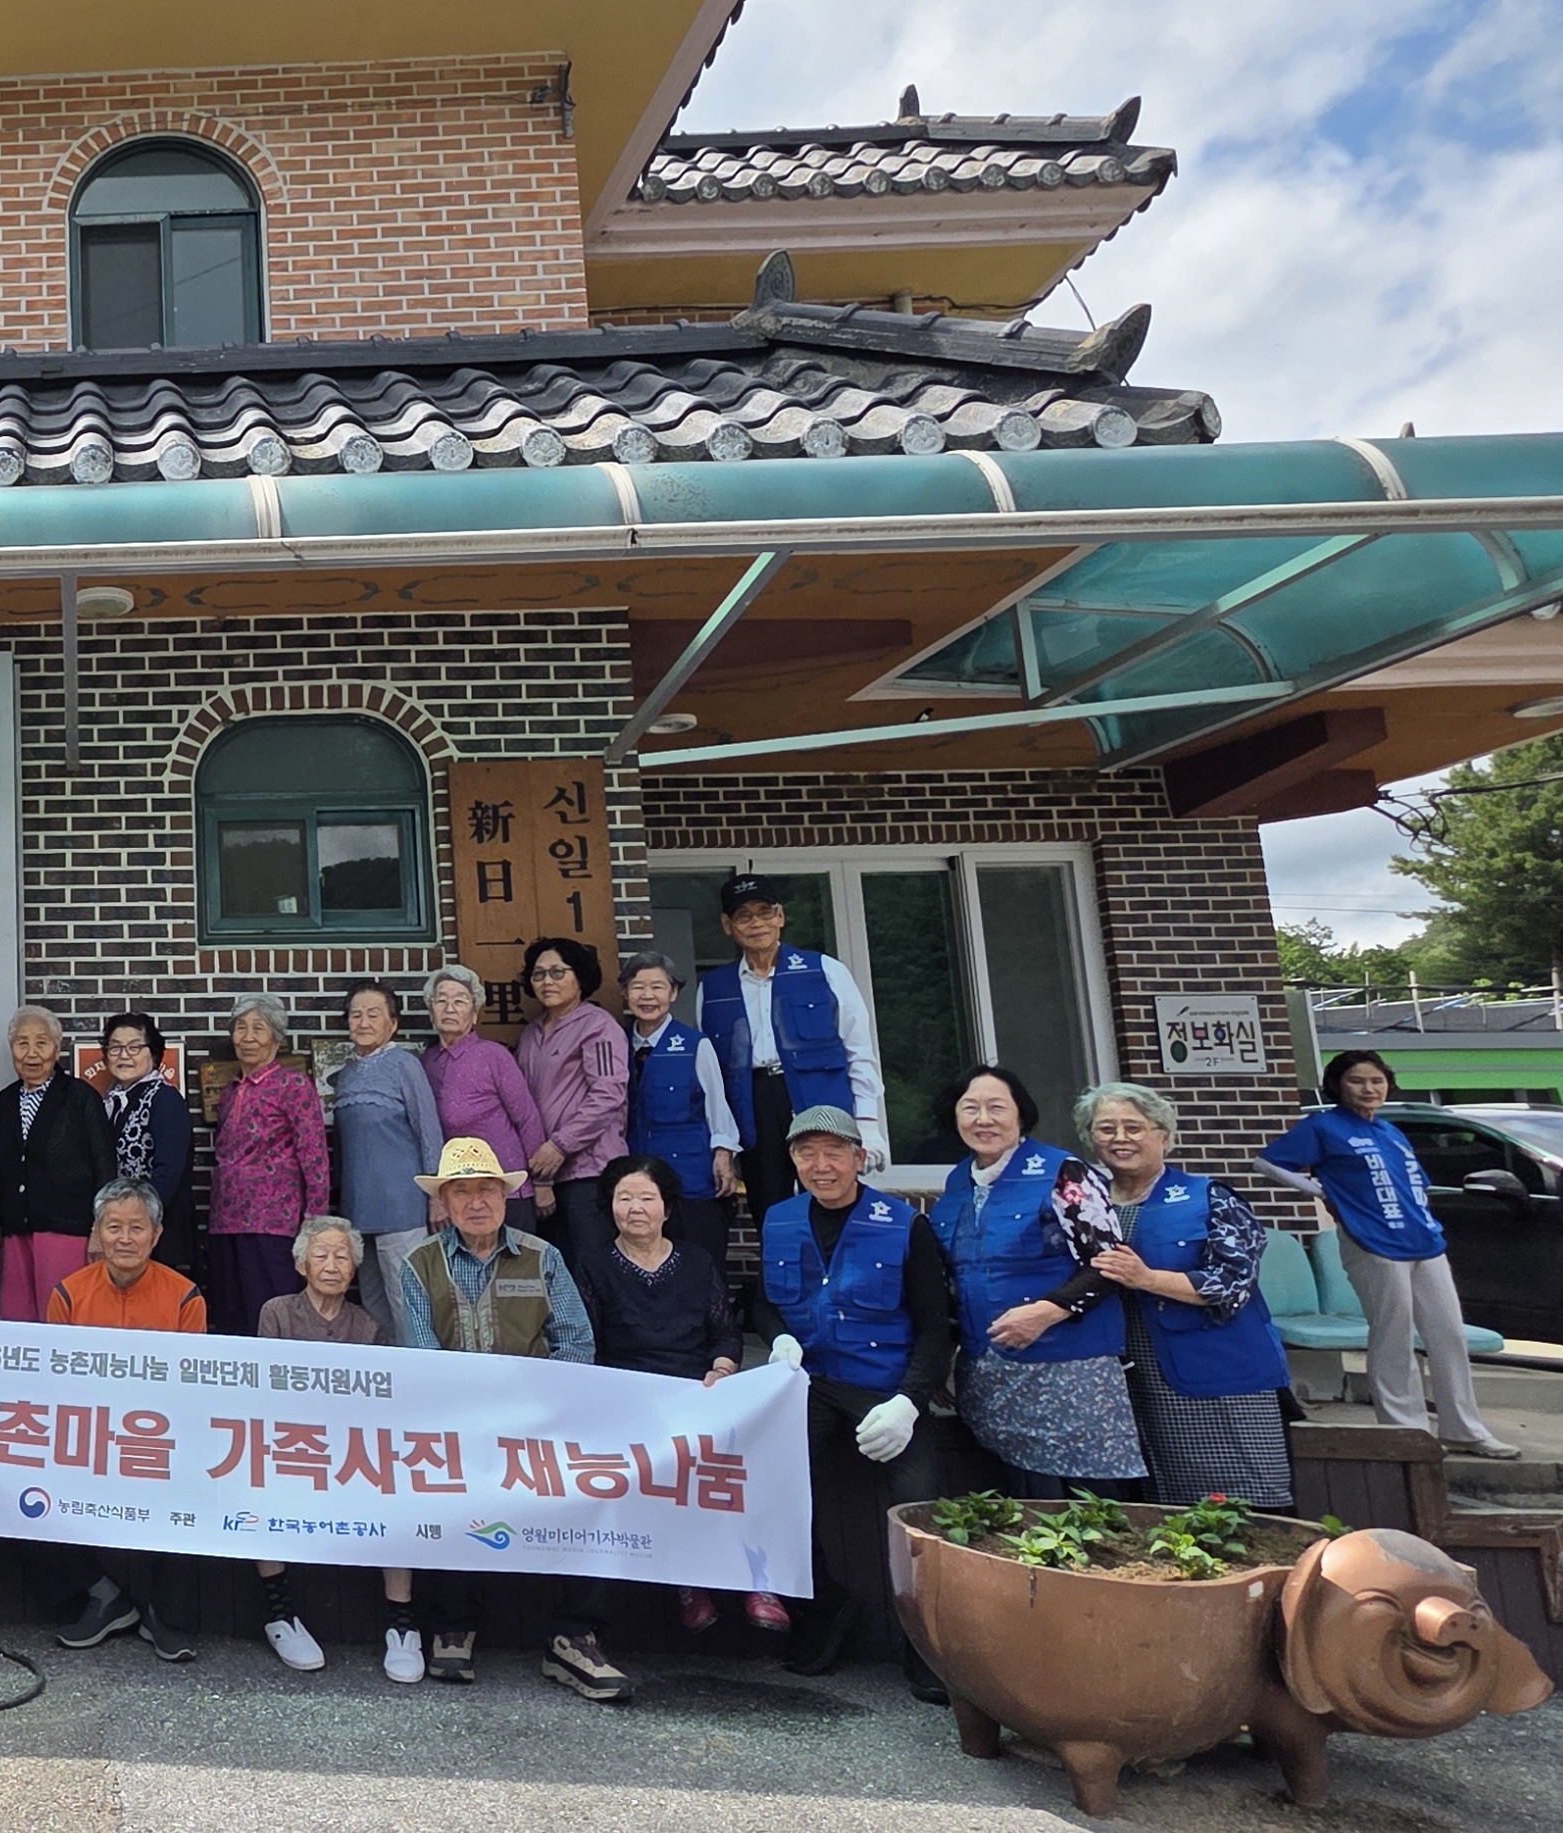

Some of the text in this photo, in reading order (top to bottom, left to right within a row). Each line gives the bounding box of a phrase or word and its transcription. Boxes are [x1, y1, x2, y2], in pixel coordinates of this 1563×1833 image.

[543, 780, 595, 940] 신일1
[468, 800, 529, 1026] 新日一里
[1166, 1020, 1259, 1064] 정보화실
[1205, 1056, 1219, 1067] 2F
[50, 1348, 169, 1382] 농촌재능나눔
[179, 1358, 260, 1388] 일반단체
[268, 1364, 394, 1399] 활동지원사업
[206, 1417, 468, 1495] 가족사진
[497, 1434, 748, 1514] 재능나눔
[58, 1499, 150, 1522] 농림축산식품부
[170, 1512, 196, 1527] 주관
[268, 1517, 653, 1550] 한국농어촌공사 시행 영월미디어기자박물관
